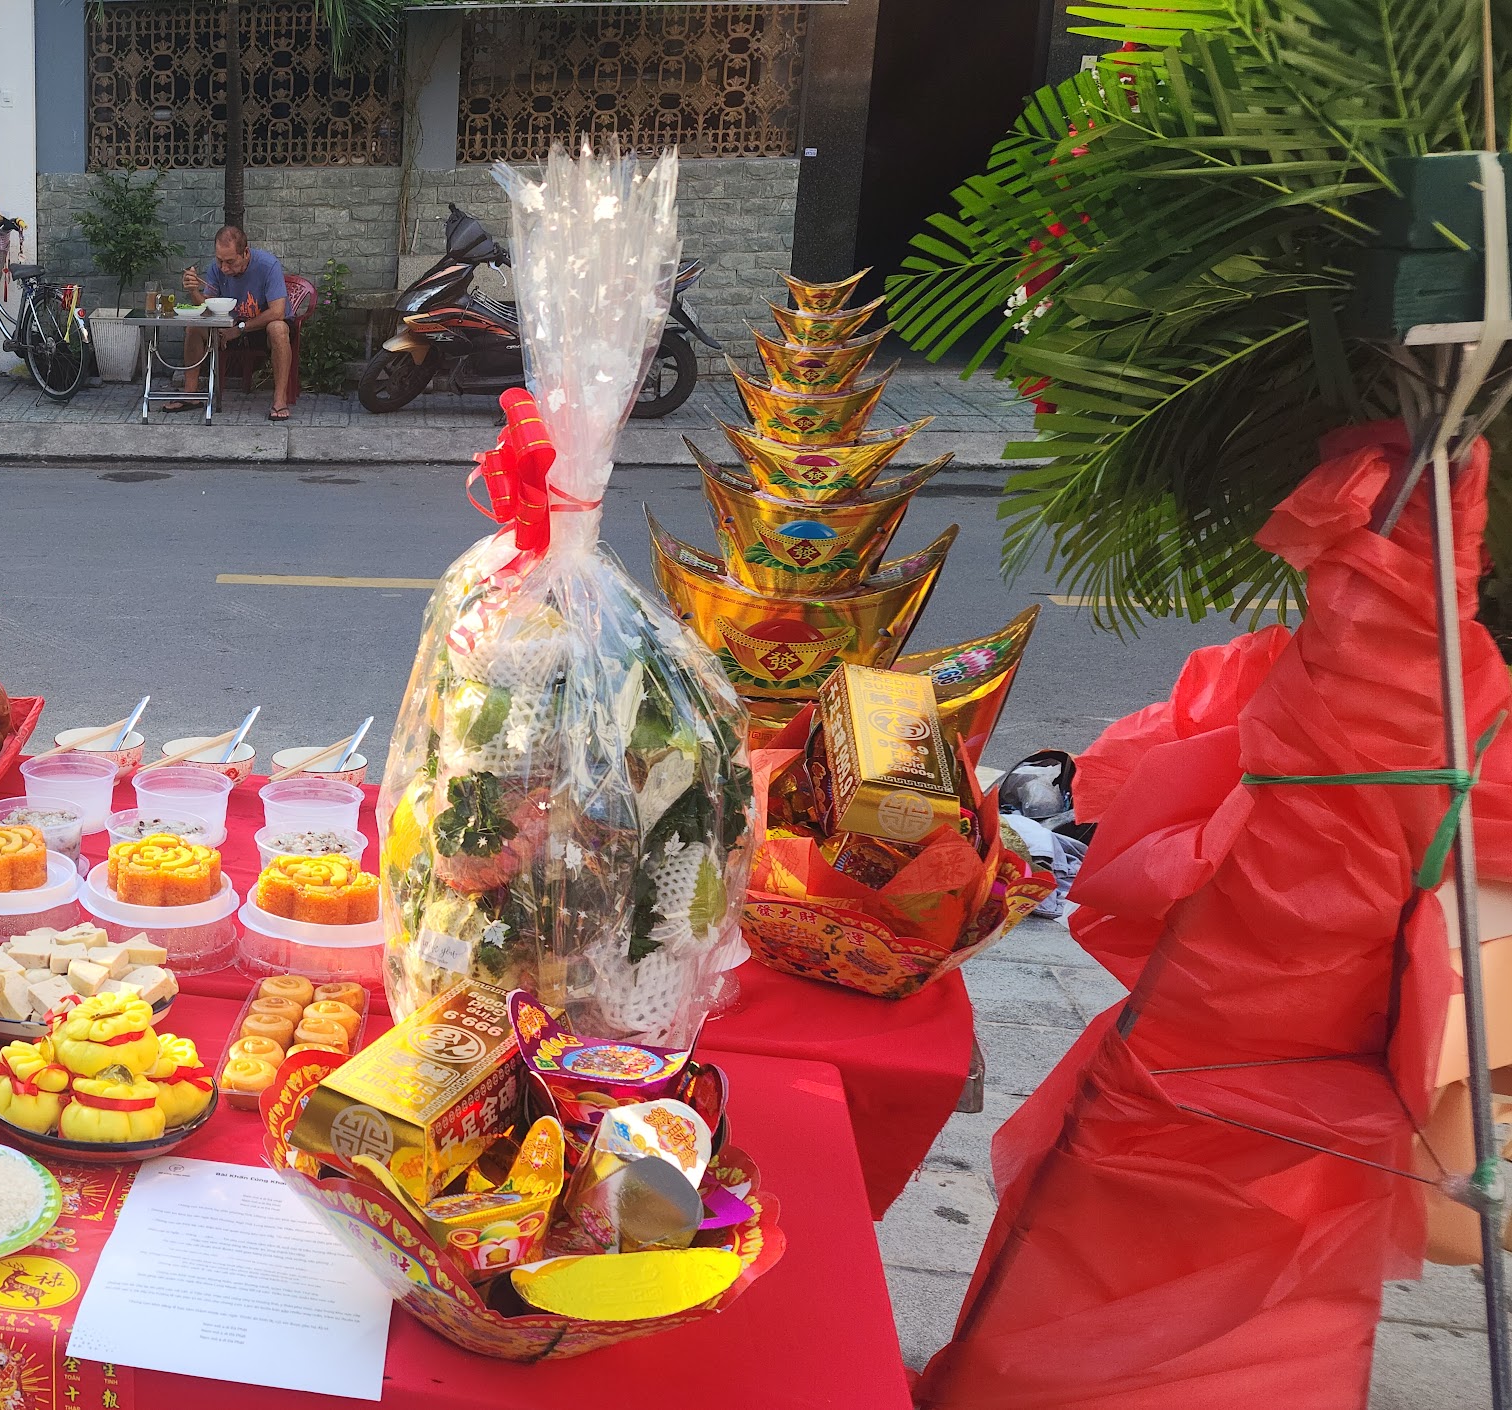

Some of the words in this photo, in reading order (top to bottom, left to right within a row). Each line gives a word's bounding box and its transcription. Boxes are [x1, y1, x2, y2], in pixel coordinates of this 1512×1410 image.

[806, 470, 825, 482] 發
[793, 545, 816, 561] 發
[766, 650, 800, 672] 發
[863, 674, 916, 689] CREDIT
[863, 682, 919, 697] SUSSIE
[877, 738, 930, 756] 999.9
[835, 745, 854, 798] 999.9
[756, 904, 818, 925] 發大財
[845, 931, 868, 948] 運
[465, 1006, 501, 1024] Fine
[467, 999, 507, 1017] Gold
[442, 1010, 504, 1037] 999.9
[356, 1073, 426, 1106] CREDIT
[370, 1065, 438, 1096] SUSSIE
[62, 1357, 81, 1373] 全
[64, 1385, 80, 1403] 十
